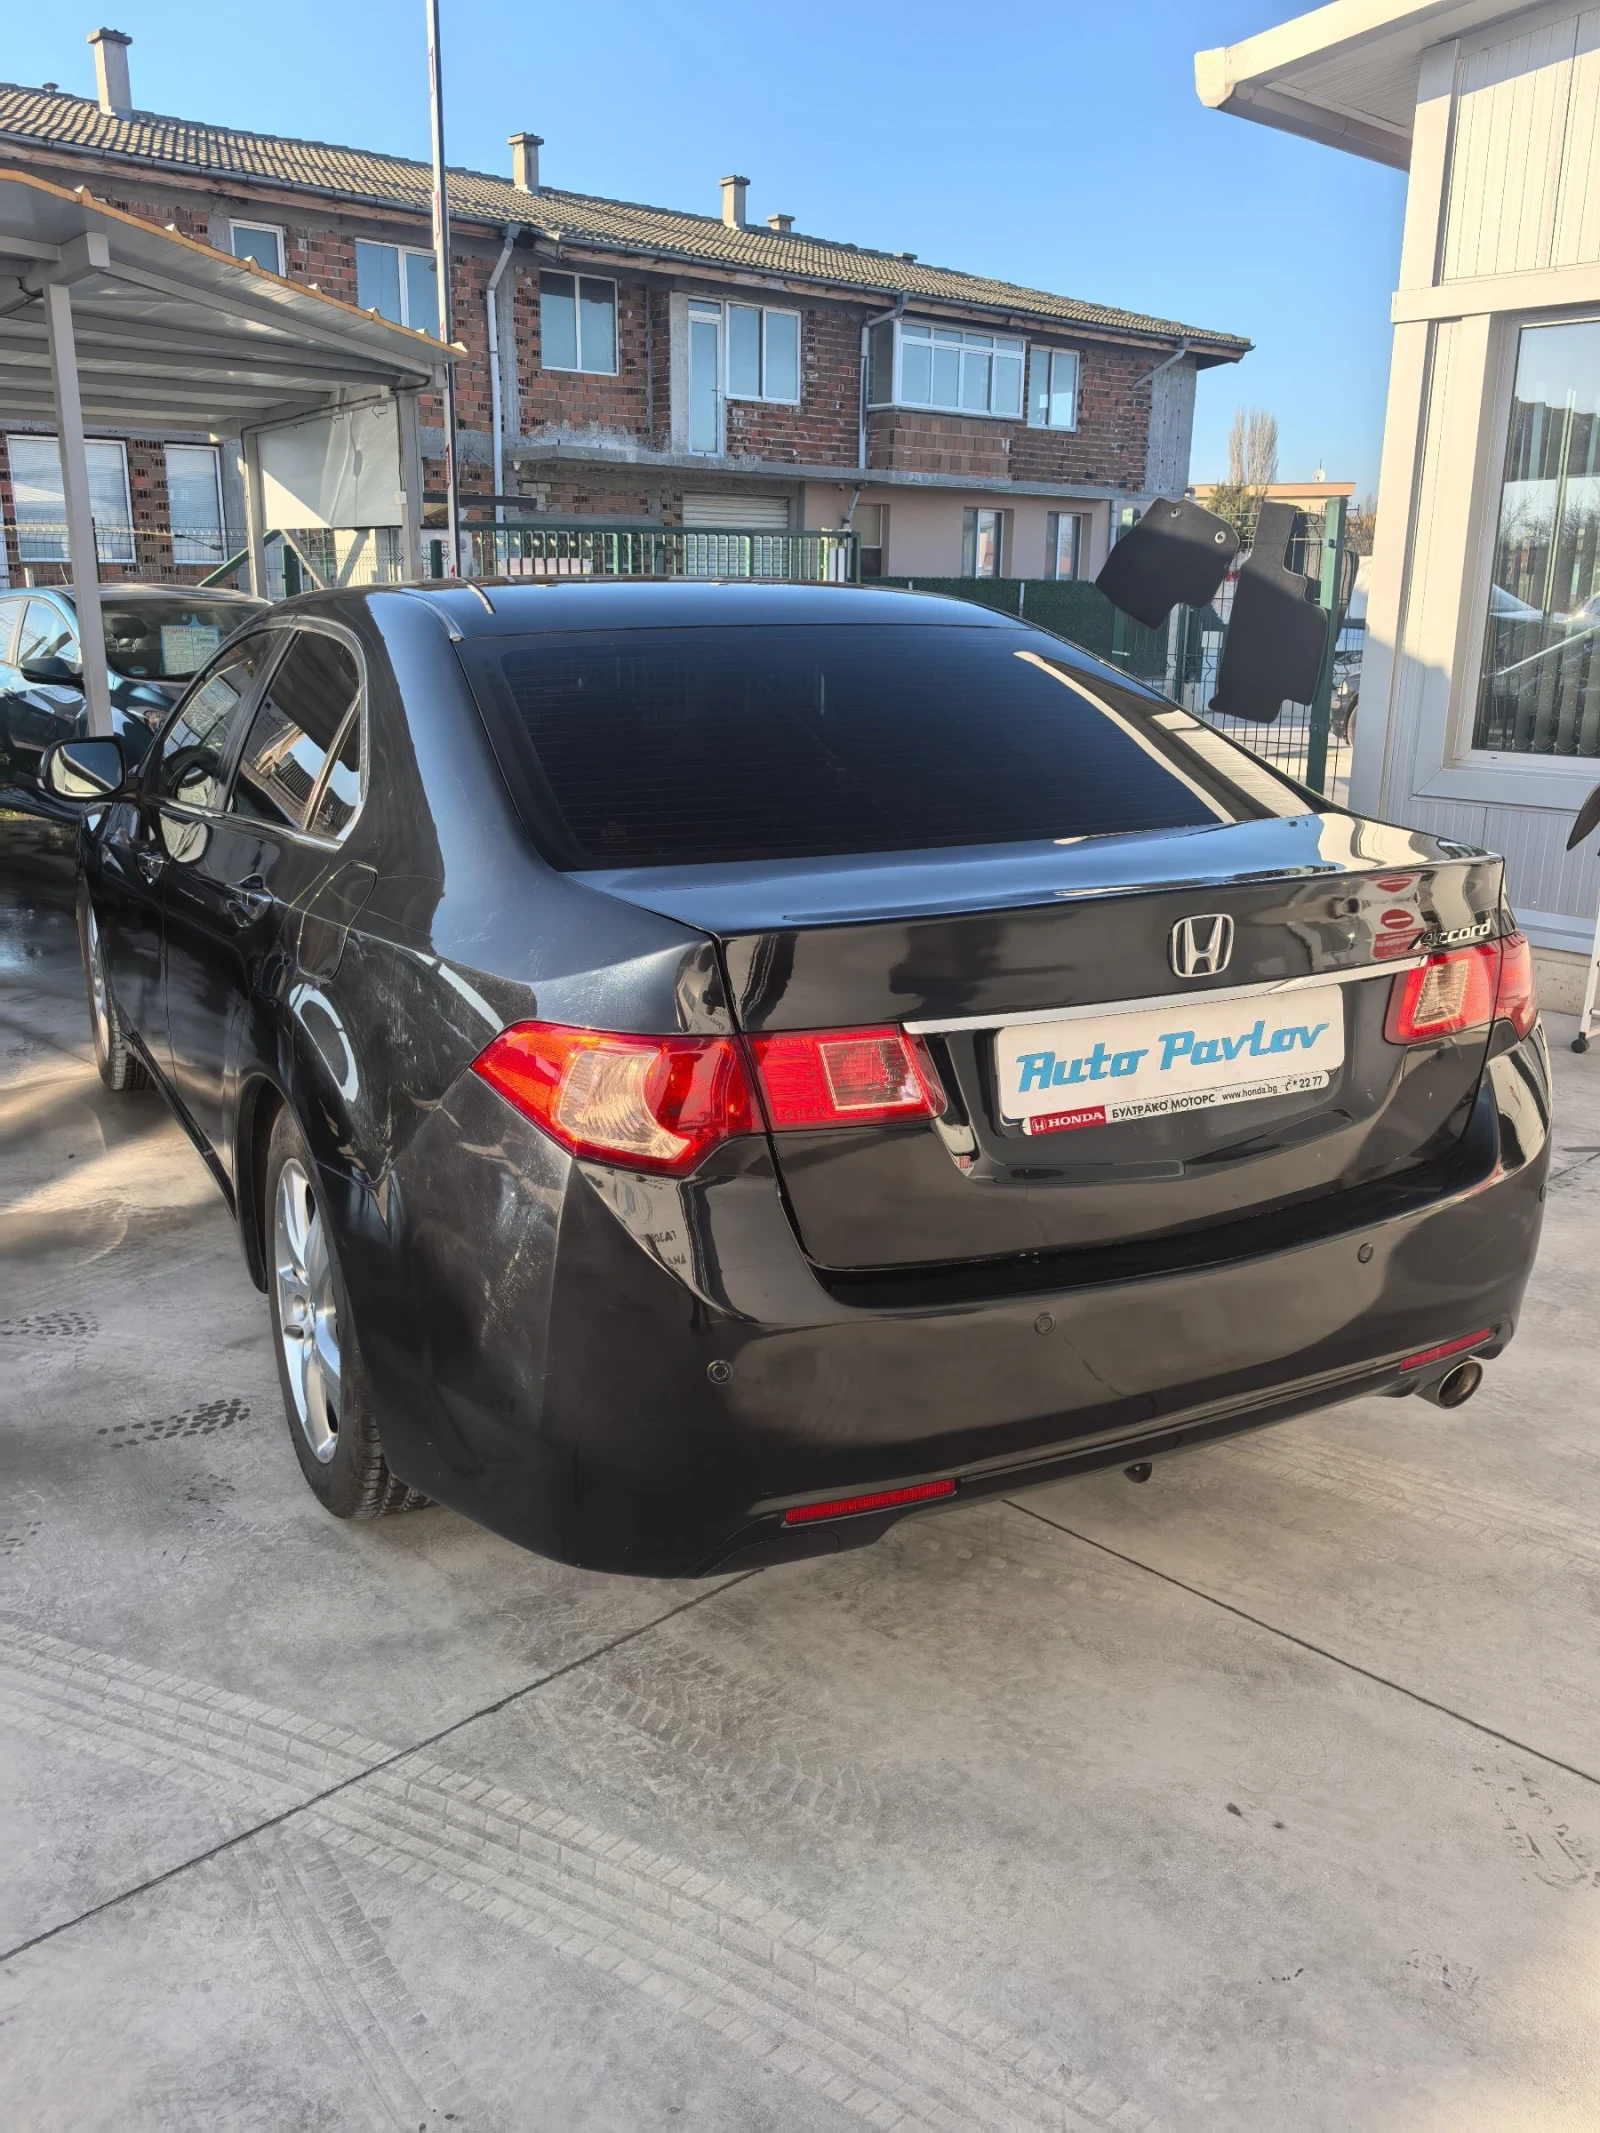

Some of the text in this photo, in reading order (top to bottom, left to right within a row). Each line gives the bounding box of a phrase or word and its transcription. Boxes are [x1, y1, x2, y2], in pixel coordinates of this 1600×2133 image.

[1419, 917, 1492, 946] Accord
[1016, 1020, 1330, 1093] Auto Pavlov
[1170, 1093, 1215, 1110] МОТОРС
[1222, 1083, 1278, 1101] www.honda.bg
[1048, 1112, 1105, 1128] HONDA
